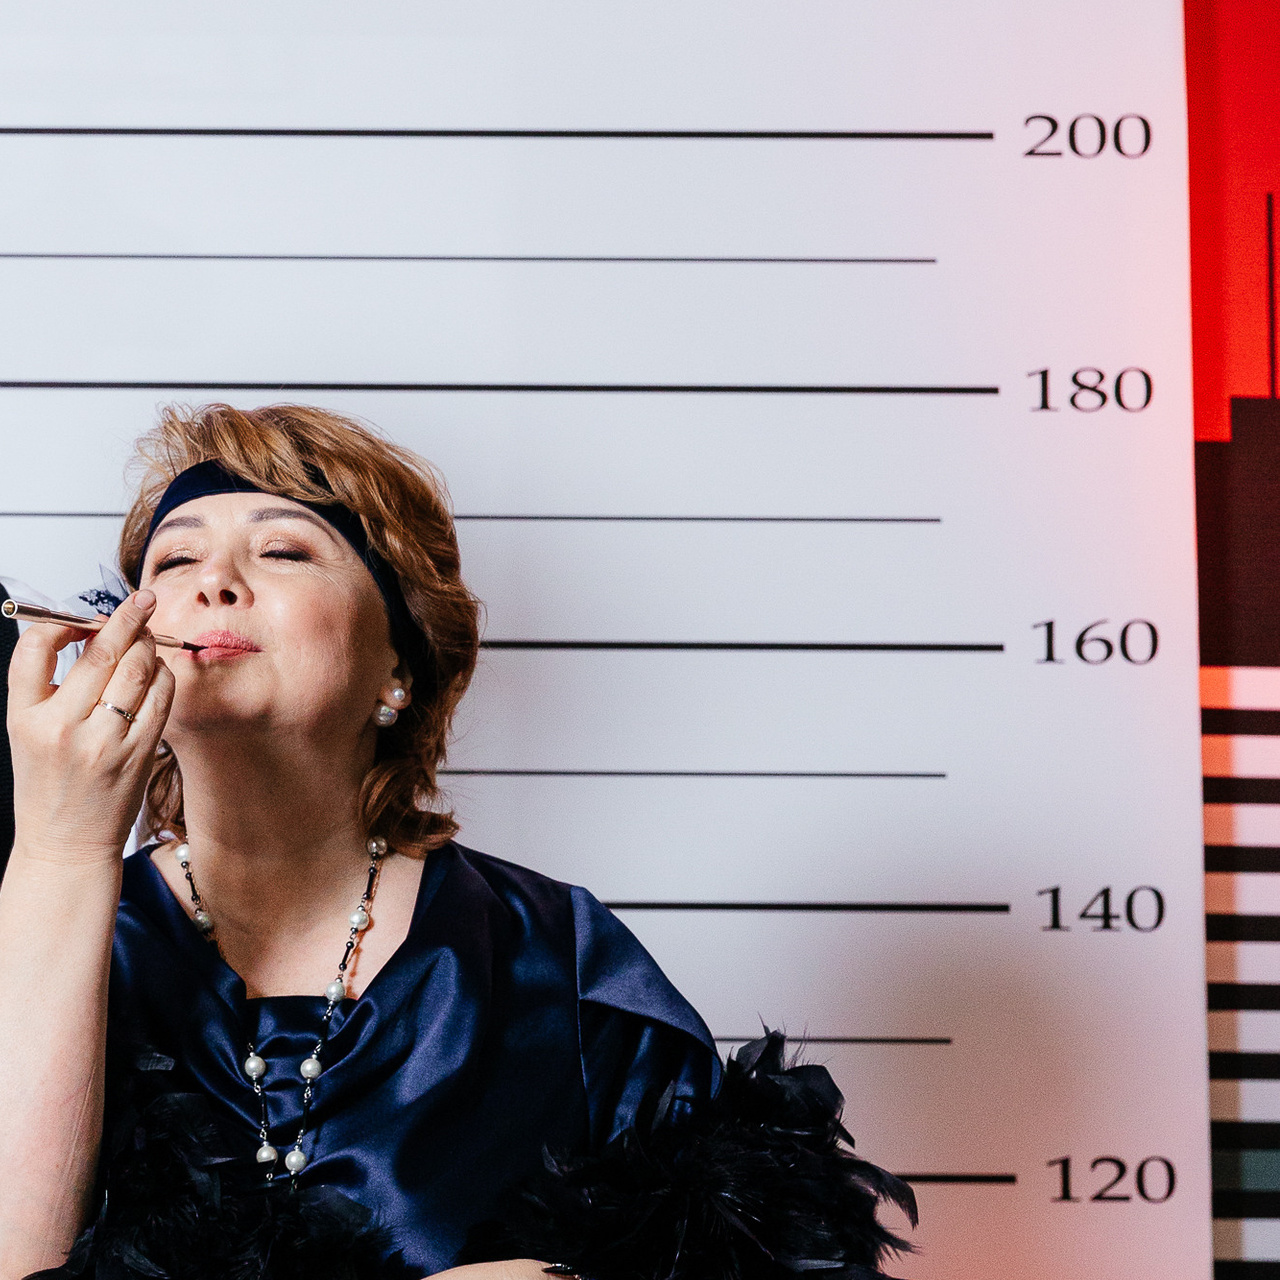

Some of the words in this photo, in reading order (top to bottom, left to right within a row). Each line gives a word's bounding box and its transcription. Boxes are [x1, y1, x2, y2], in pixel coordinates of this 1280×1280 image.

[1022, 112, 1153, 159] 200
[1026, 366, 1153, 413] 180
[1031, 618, 1160, 665] 160
[1036, 885, 1166, 933] 140
[1046, 1155, 1176, 1204] 120
